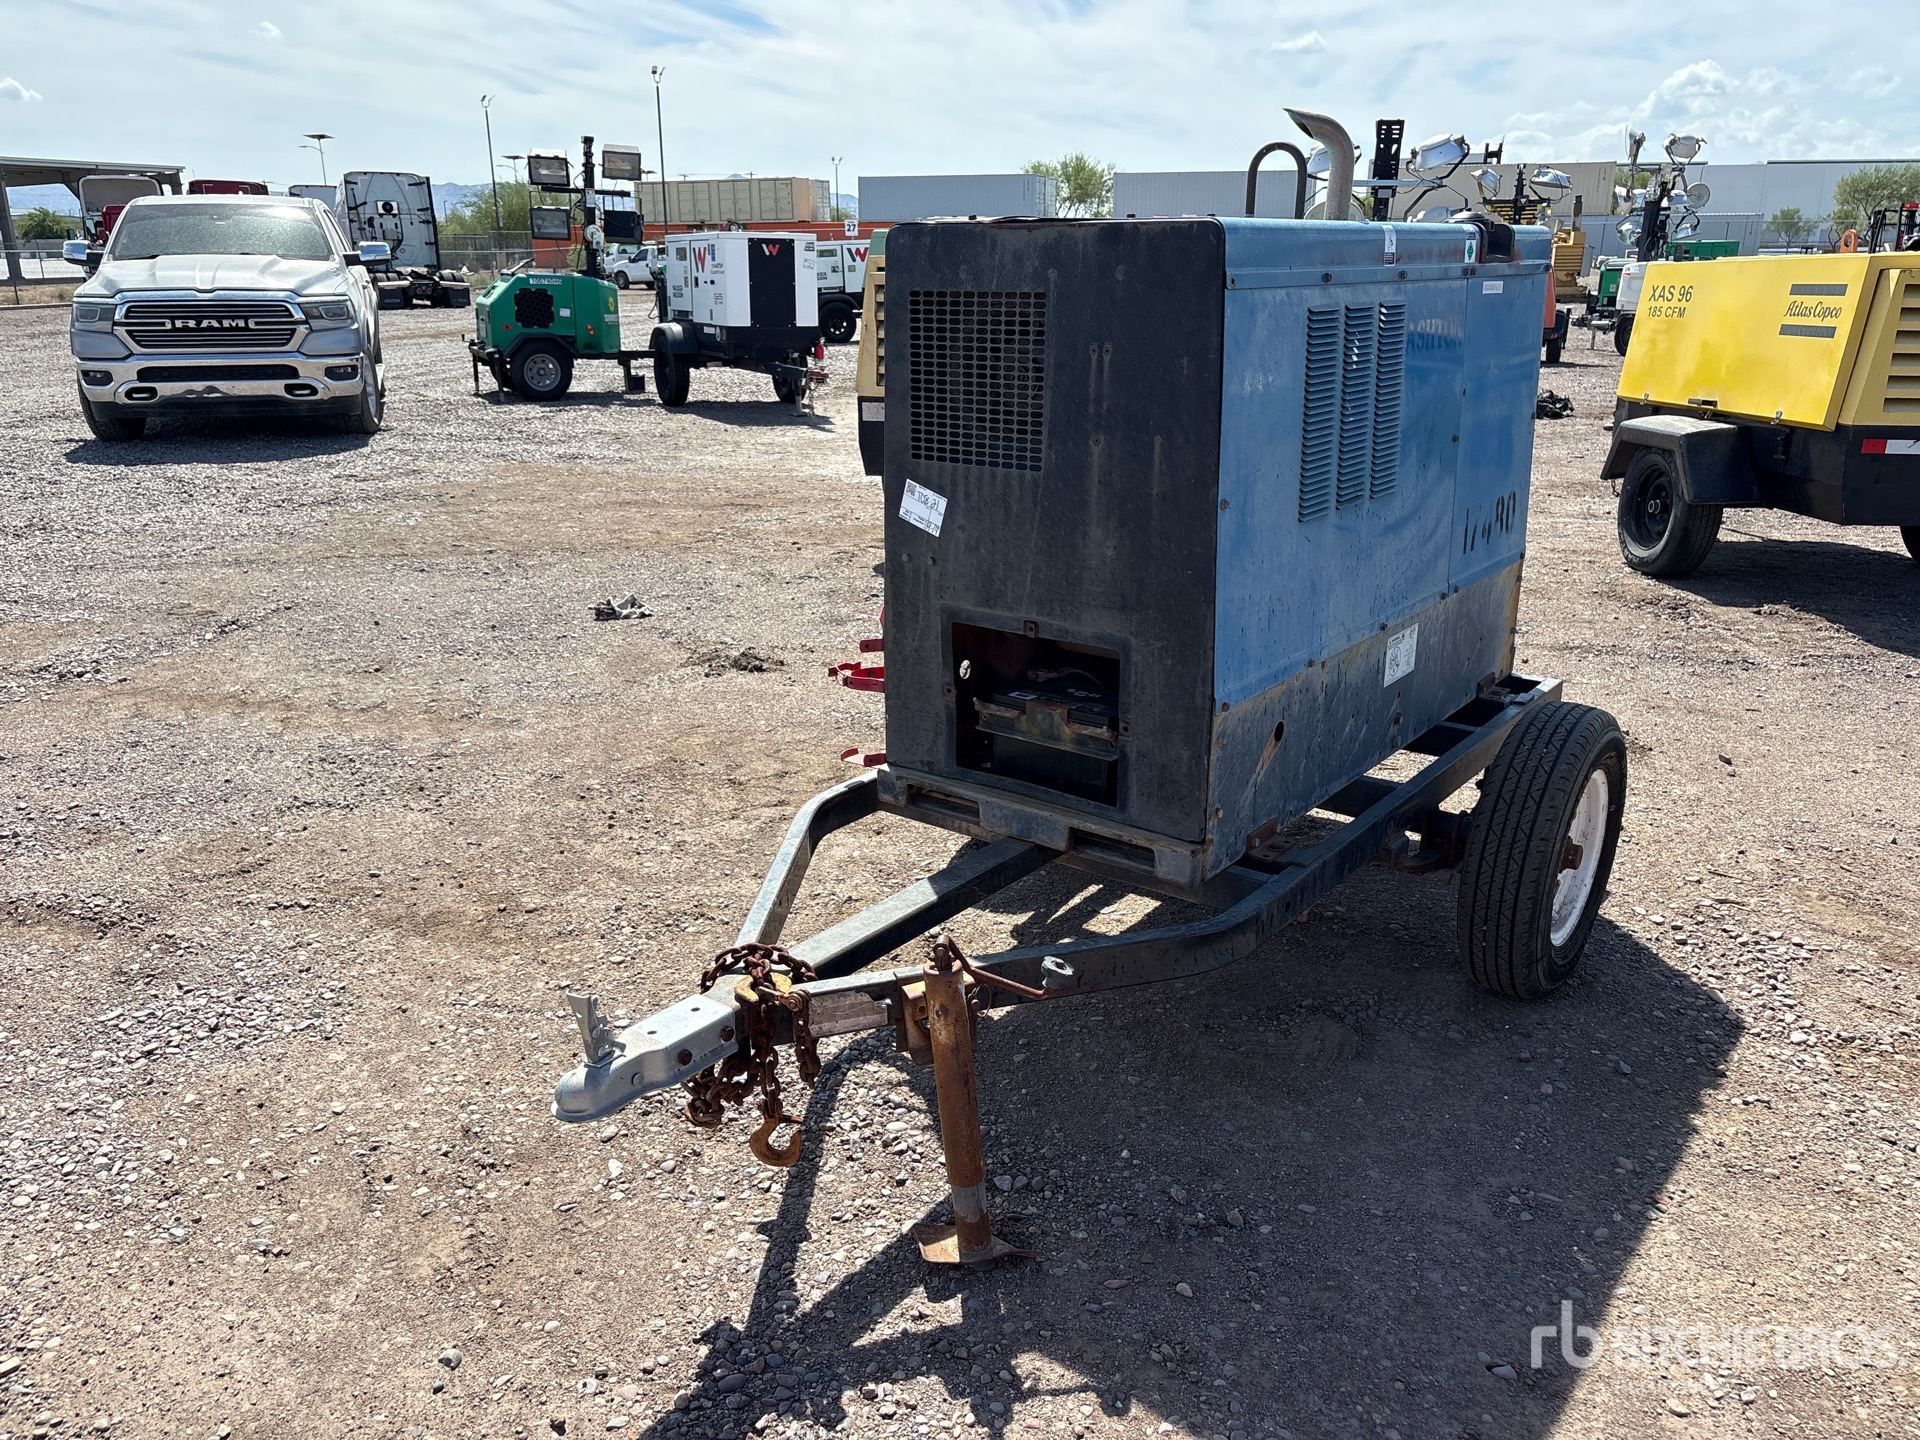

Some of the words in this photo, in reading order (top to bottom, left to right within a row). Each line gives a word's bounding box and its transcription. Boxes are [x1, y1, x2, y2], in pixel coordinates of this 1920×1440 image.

[846, 224, 857, 232] 27
[1649, 285, 1676, 302] XAS
[1678, 285, 1694, 302] 96
[1648, 306, 1663, 317] 185
[1665, 307, 1686, 318] CFM
[174, 319, 246, 328] RAM
